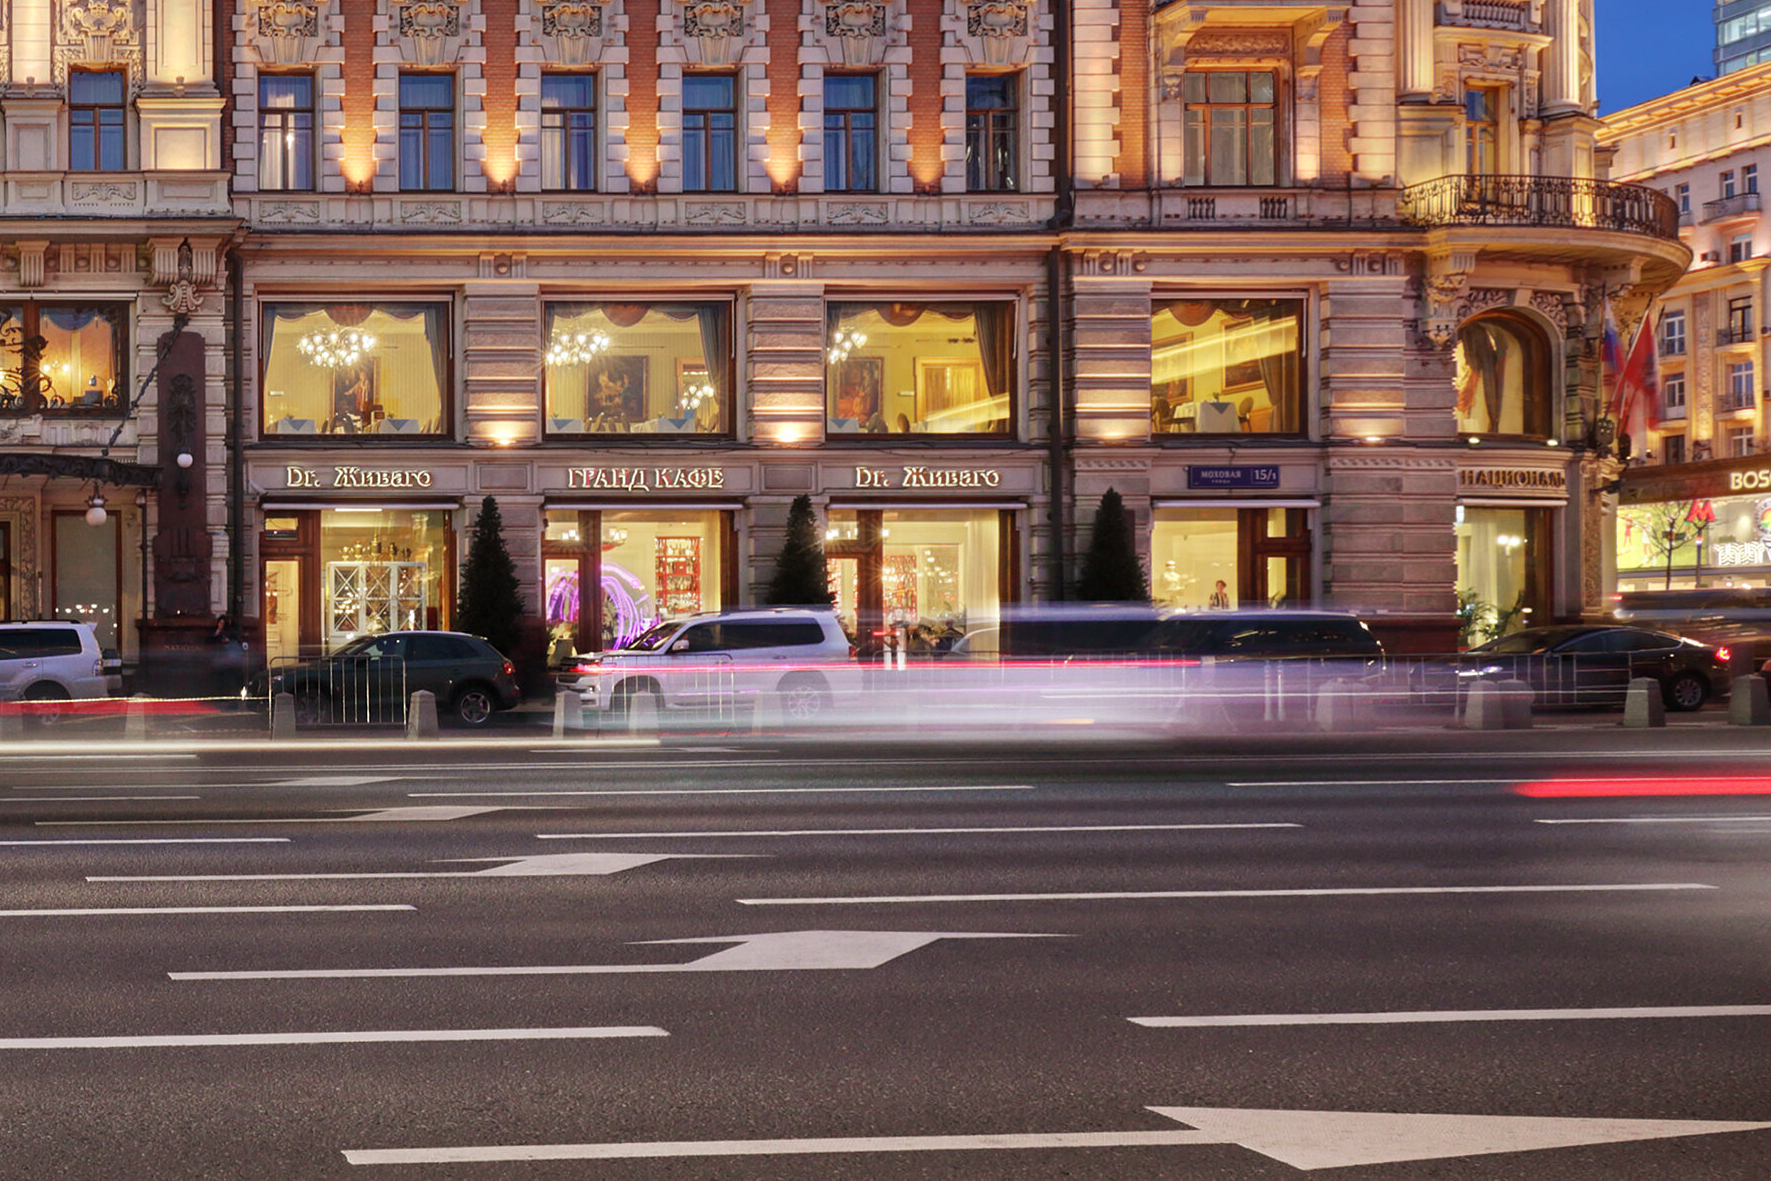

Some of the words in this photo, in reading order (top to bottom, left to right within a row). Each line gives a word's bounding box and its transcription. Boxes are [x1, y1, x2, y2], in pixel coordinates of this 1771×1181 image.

[286, 466, 321, 488] Dr.
[333, 466, 434, 488] Живаго
[568, 467, 650, 492] ГРАНД
[654, 467, 725, 489] КАФЕ
[855, 466, 891, 488] Dr.
[902, 466, 1003, 488] Живаго
[1201, 470, 1242, 479] МОХОВАЯ
[1254, 468, 1277, 481] 15/1
[1461, 469, 1566, 488] НАЦИОНАЛЬ
[1730, 469, 1771, 491] BOS
